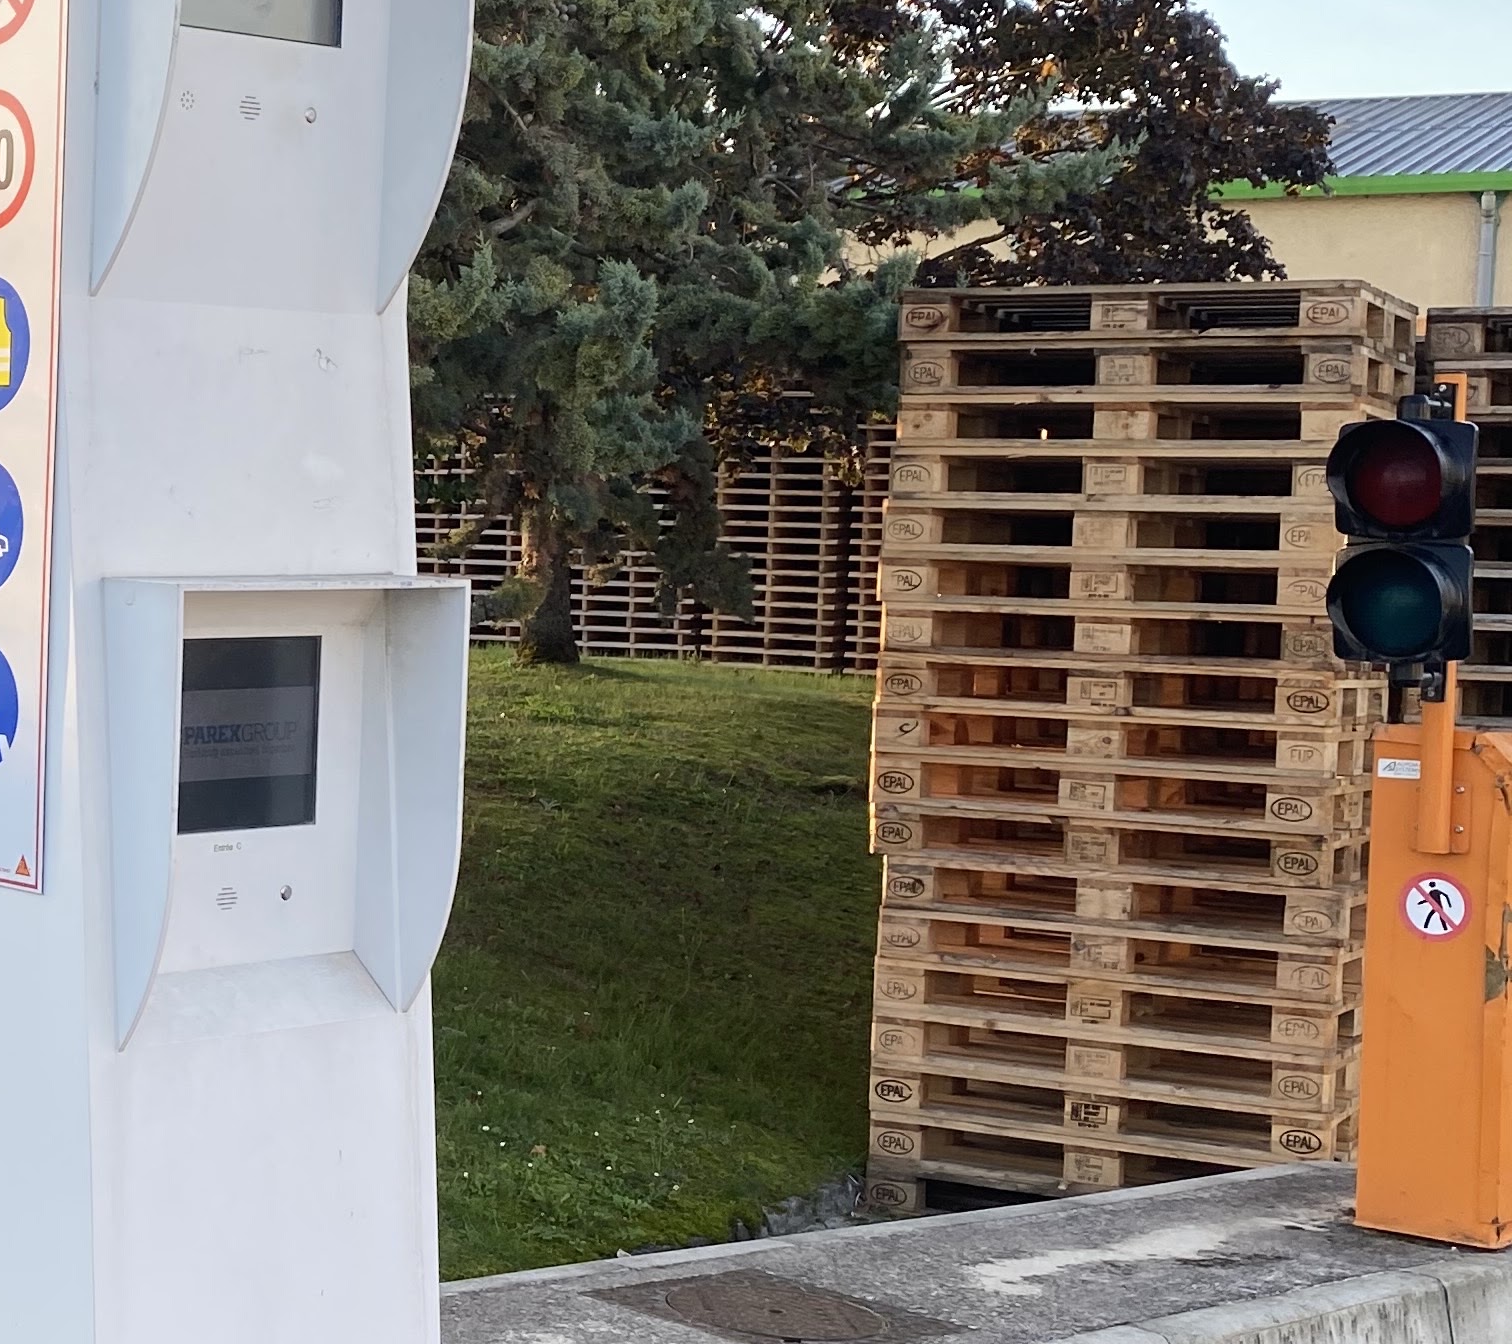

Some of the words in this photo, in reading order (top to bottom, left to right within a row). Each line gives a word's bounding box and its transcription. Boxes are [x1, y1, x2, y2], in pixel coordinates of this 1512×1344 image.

[1293, 694, 1322, 709] EPAL
[183, 721, 297, 745] PAREXGROUP
[1277, 802, 1306, 816] EPAL
[1283, 856, 1313, 871] EPAL
[880, 1084, 907, 1097] EPAL
[1283, 1079, 1313, 1096] EPAL
[882, 1135, 909, 1151] EPAL
[1285, 1133, 1315, 1151] EPAL
